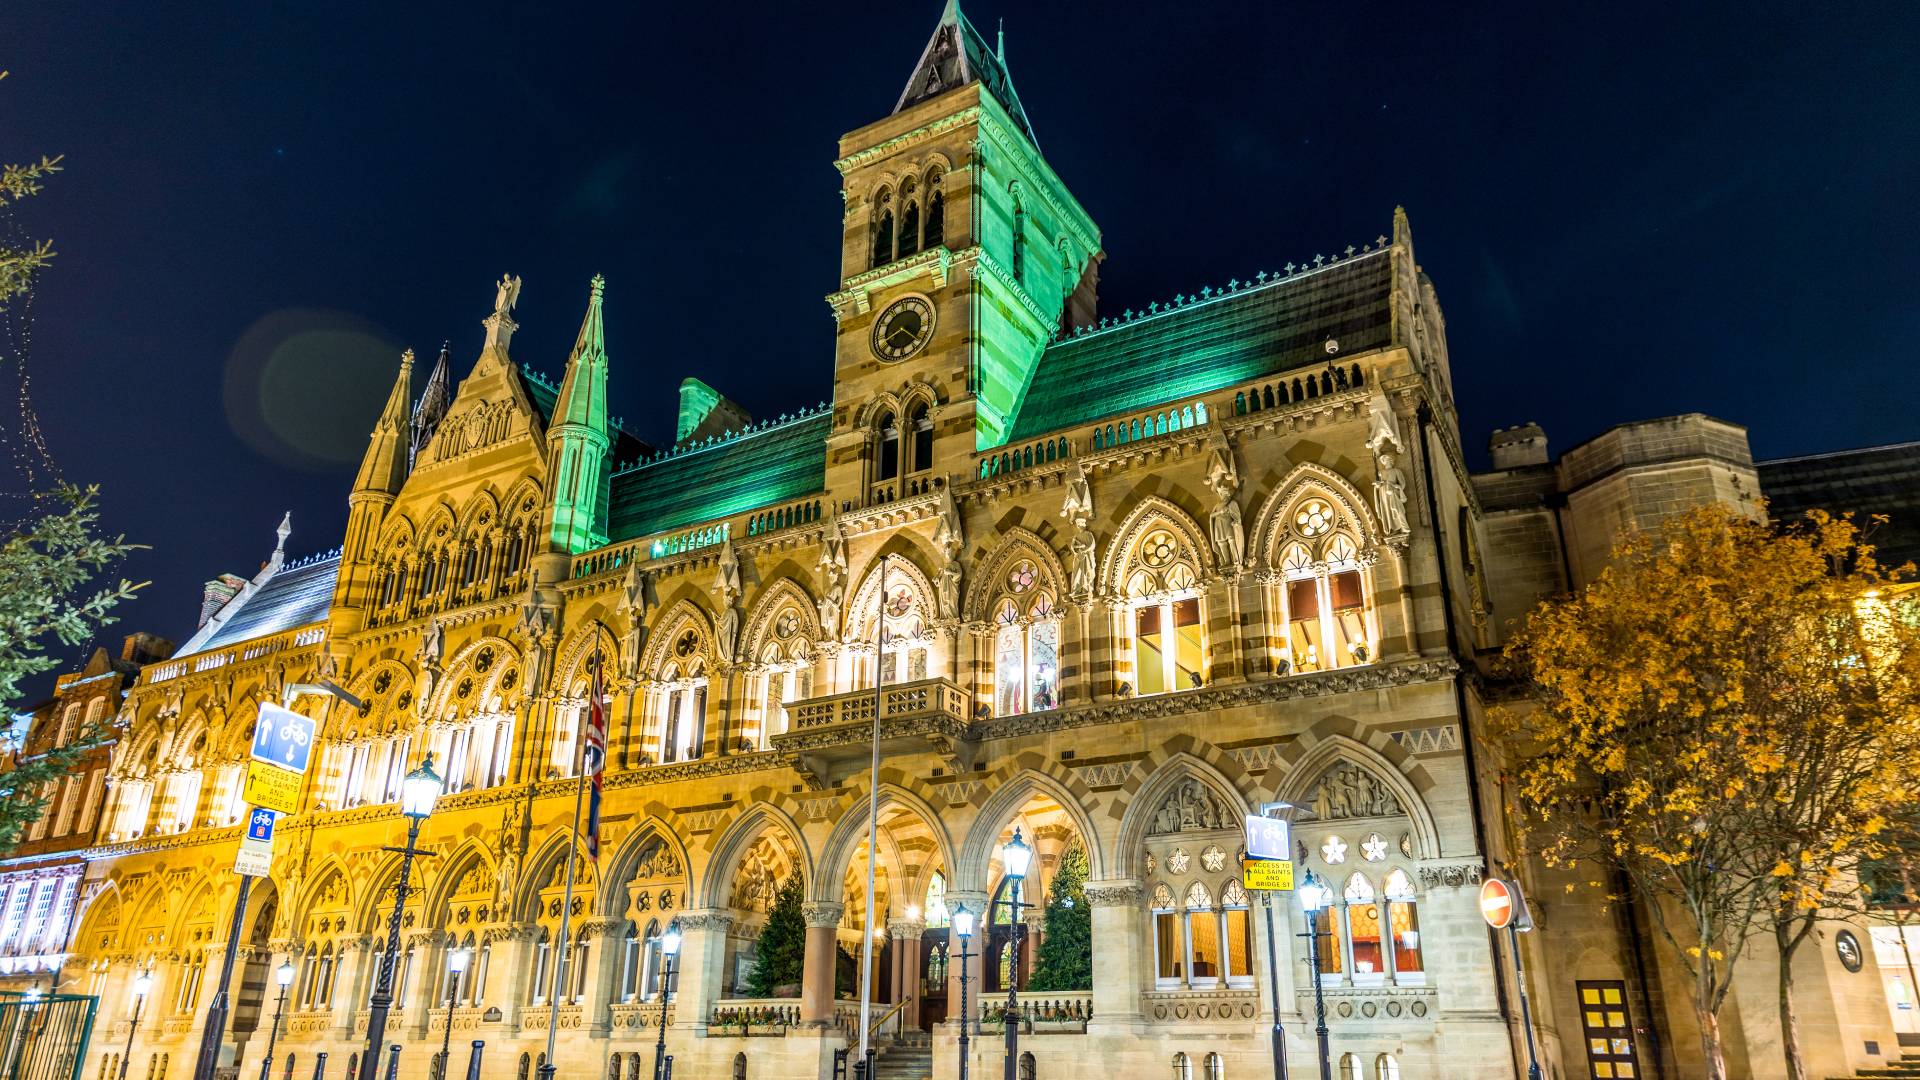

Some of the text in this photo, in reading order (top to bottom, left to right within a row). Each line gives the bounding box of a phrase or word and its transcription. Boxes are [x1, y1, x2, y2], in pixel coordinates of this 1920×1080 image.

[261, 768, 300, 784] ACCESS TO
[259, 776, 299, 793] ALL SAINTS
[257, 793, 283, 807] BRIDGE
[270, 788, 284, 797] AND
